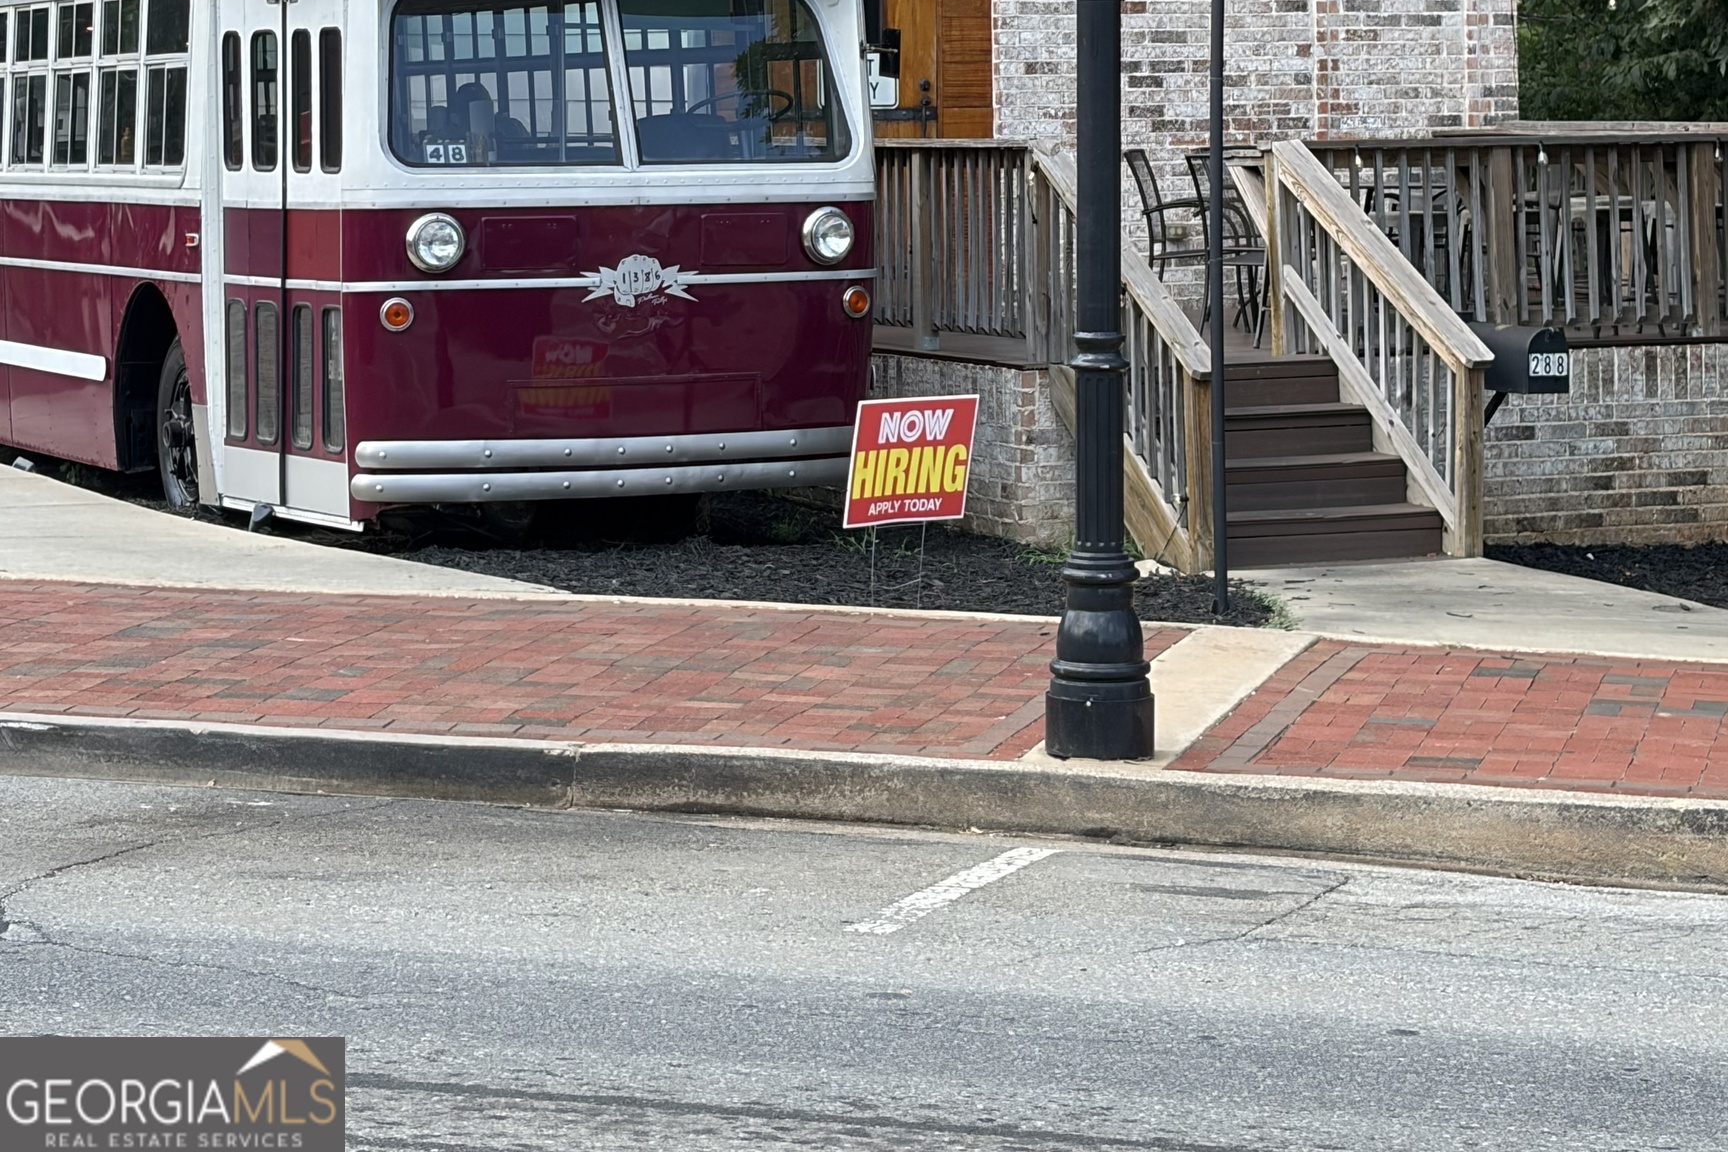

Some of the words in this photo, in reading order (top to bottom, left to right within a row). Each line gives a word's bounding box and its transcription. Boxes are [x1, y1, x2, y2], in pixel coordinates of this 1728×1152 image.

[622, 269, 661, 285] 1386
[1532, 355, 1564, 375] 288
[878, 408, 955, 444] NOW
[852, 444, 968, 500] HIRING
[868, 500, 901, 516] APPLY
[904, 497, 942, 513] TODAY
